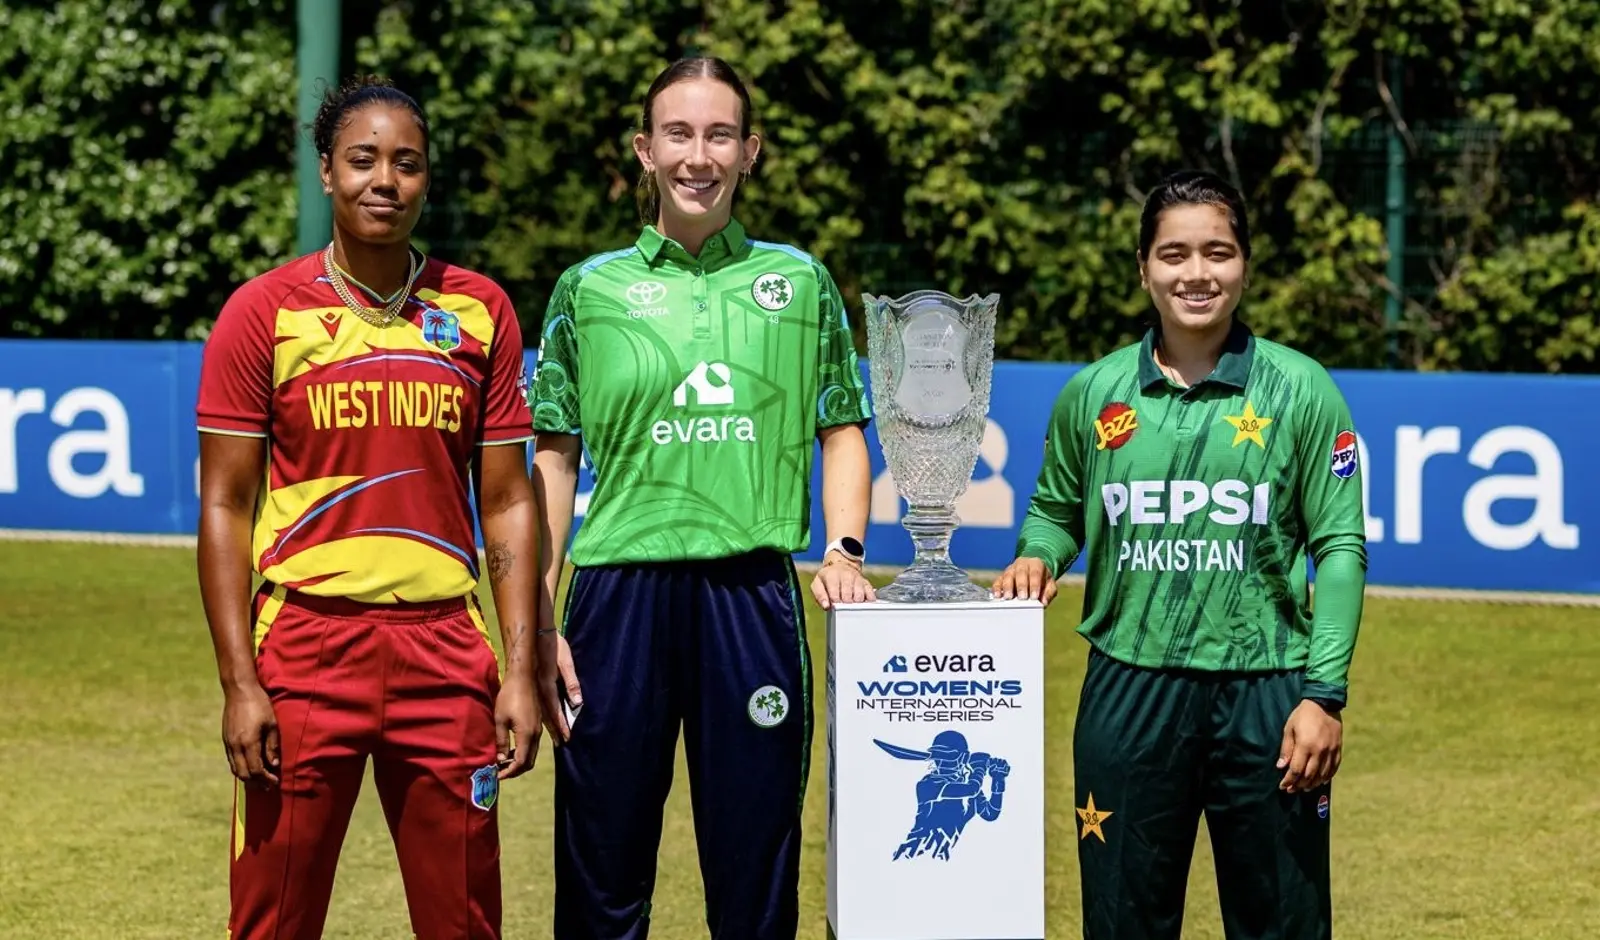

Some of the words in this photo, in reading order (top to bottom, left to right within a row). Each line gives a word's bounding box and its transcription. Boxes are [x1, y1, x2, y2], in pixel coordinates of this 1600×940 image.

[626, 307, 670, 319] TOYOTA
[306, 381, 384, 430] WEST
[388, 381, 464, 433] INDIES
[651, 416, 756, 445] evara
[1094, 409, 1138, 450] Jazz
[1356, 425, 1580, 550] ra
[1101, 479, 1270, 526] PEPSI
[1117, 539, 1244, 572] PAKISTAN
[914, 654, 996, 672] evara
[857, 680, 1023, 697] WOMEN'S
[856, 698, 1022, 710] INTERNATIONAL
[883, 711, 994, 722] TRI-SERIES
